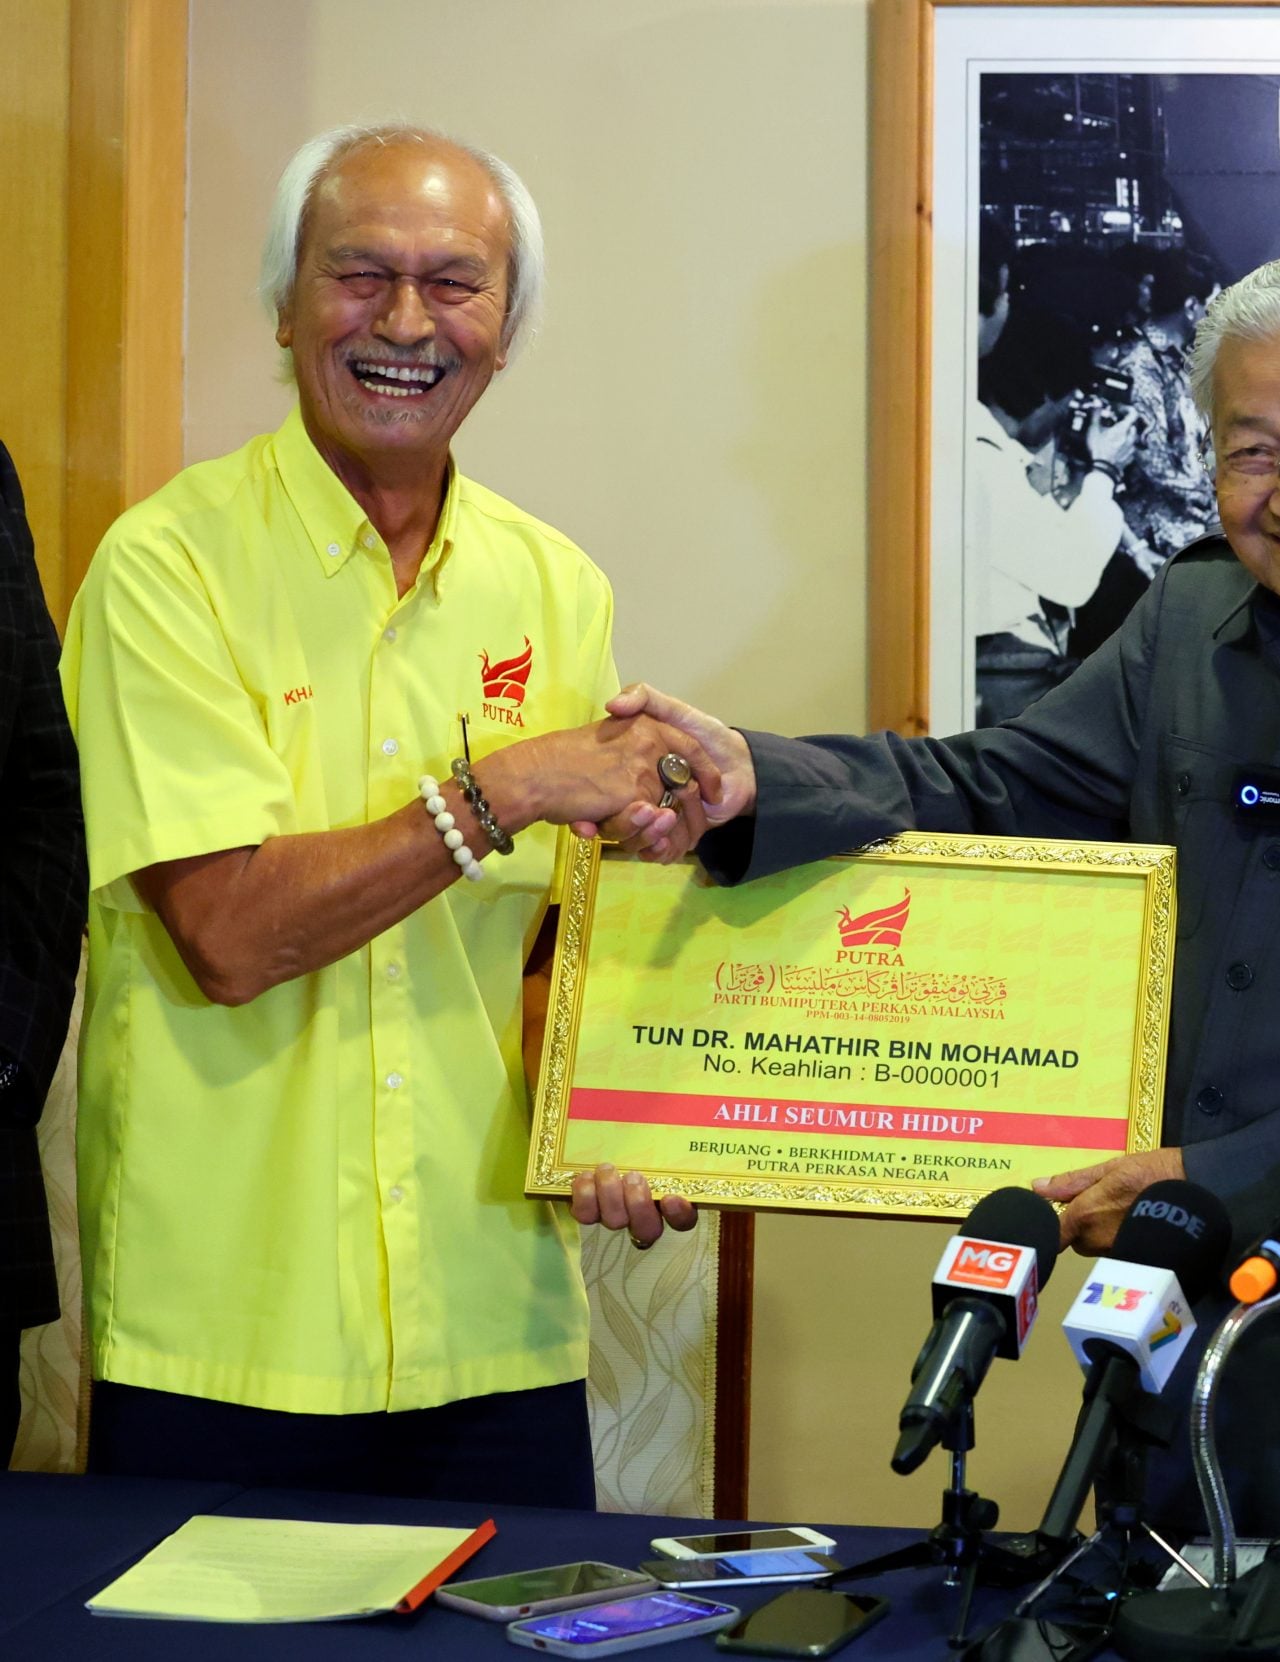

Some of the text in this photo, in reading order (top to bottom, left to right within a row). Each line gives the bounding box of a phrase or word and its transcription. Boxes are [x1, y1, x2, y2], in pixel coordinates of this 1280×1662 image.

[482, 703, 525, 727] PUTRA
[836, 950, 905, 967] PUTRA
[713, 993, 1005, 1020] PARTI BUMIPUTERA PERKASA MALAYSIA
[806, 1010, 910, 1024] PPM-003-14-08052019
[632, 1026, 1079, 1068] TUN DR. MAHATHIR BIN MOHAMAD
[703, 1054, 741, 1074] No.
[751, 1056, 851, 1080] Keahlian
[875, 1063, 1000, 1088] B-0000001
[713, 1103, 984, 1135] AHLI SEUMUR HIDUP
[689, 1141, 1012, 1170] BERJUANG BERKHIDMAT BERKORBAN
[747, 1159, 950, 1181] PUTRA PERKASA NEGARA
[959, 1246, 1014, 1272] MG
